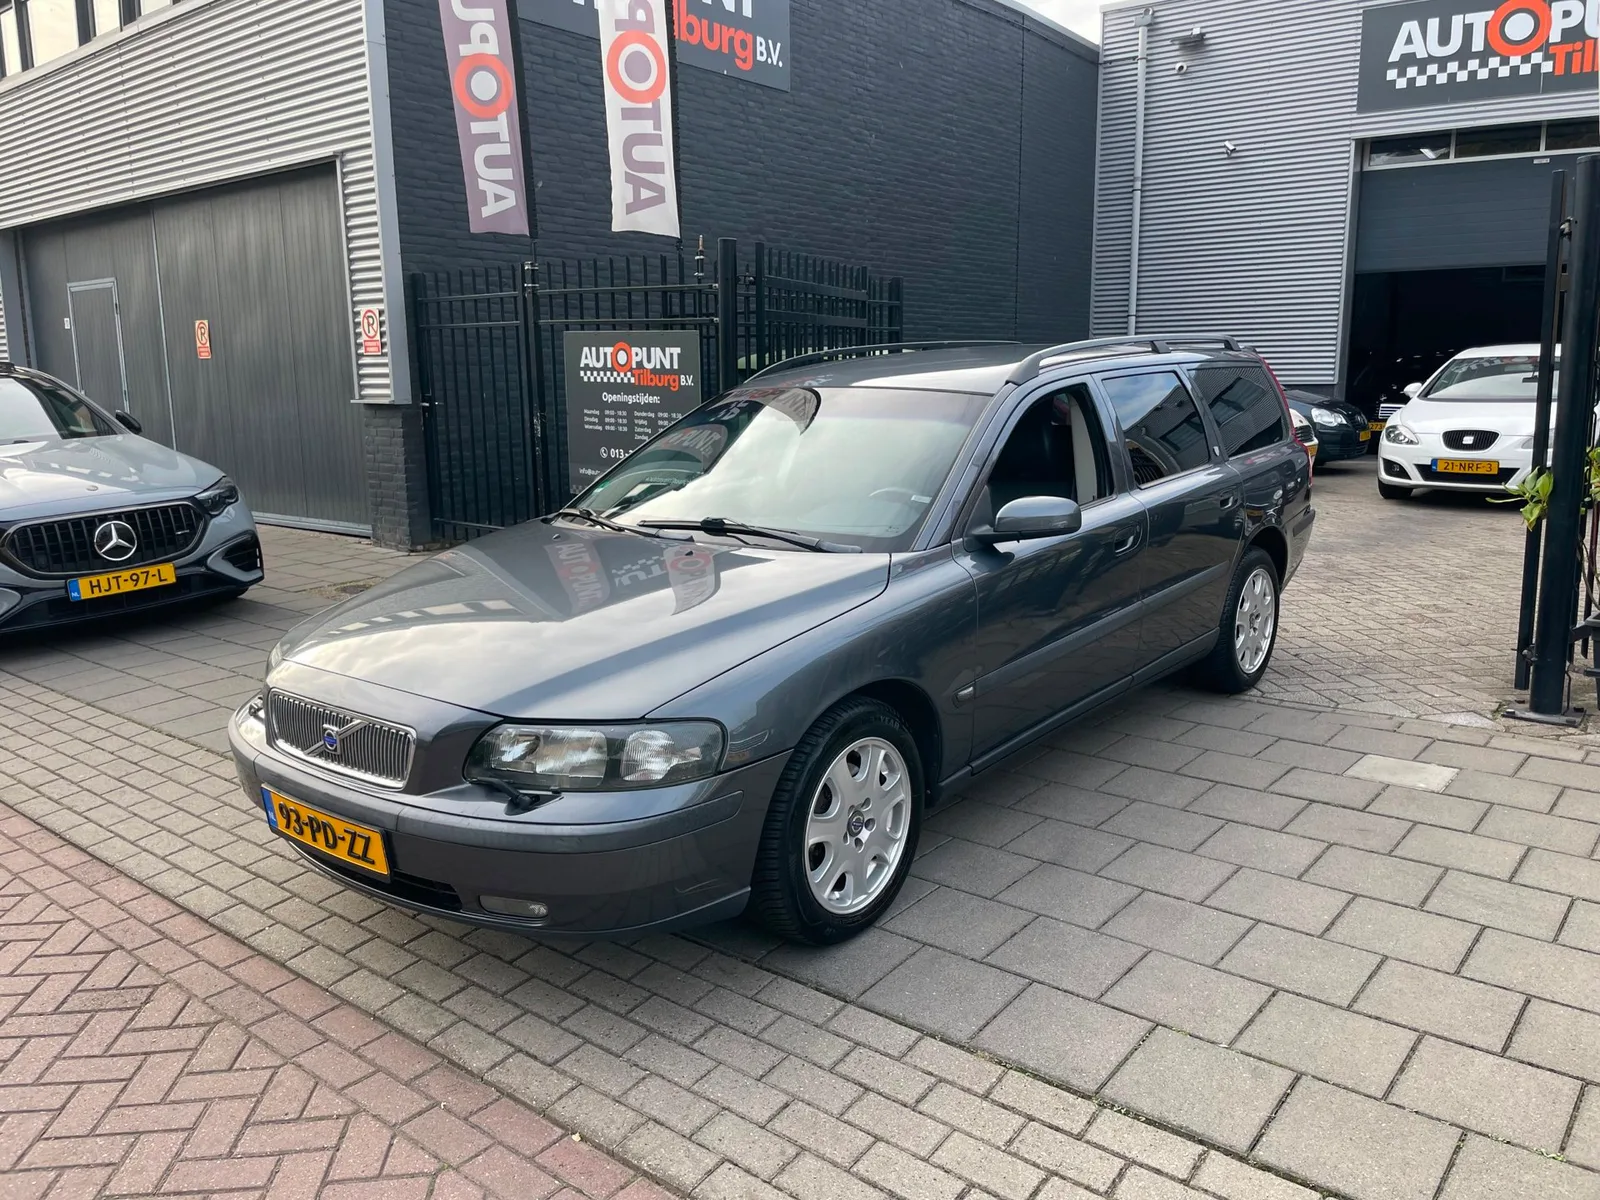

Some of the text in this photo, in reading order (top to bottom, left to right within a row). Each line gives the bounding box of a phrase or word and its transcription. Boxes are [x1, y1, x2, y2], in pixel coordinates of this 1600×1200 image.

[756, 35, 783, 68] B.V.
[580, 341, 682, 373] AUTOPUNT
[631, 368, 694, 392] Tilburg B.V.
[602, 391, 661, 405] Openingstijden:
[1443, 461, 1493, 473] 21-NRF-3
[89, 568, 168, 595] HJT-97-L
[278, 801, 375, 865] 93-PD-ZZ
